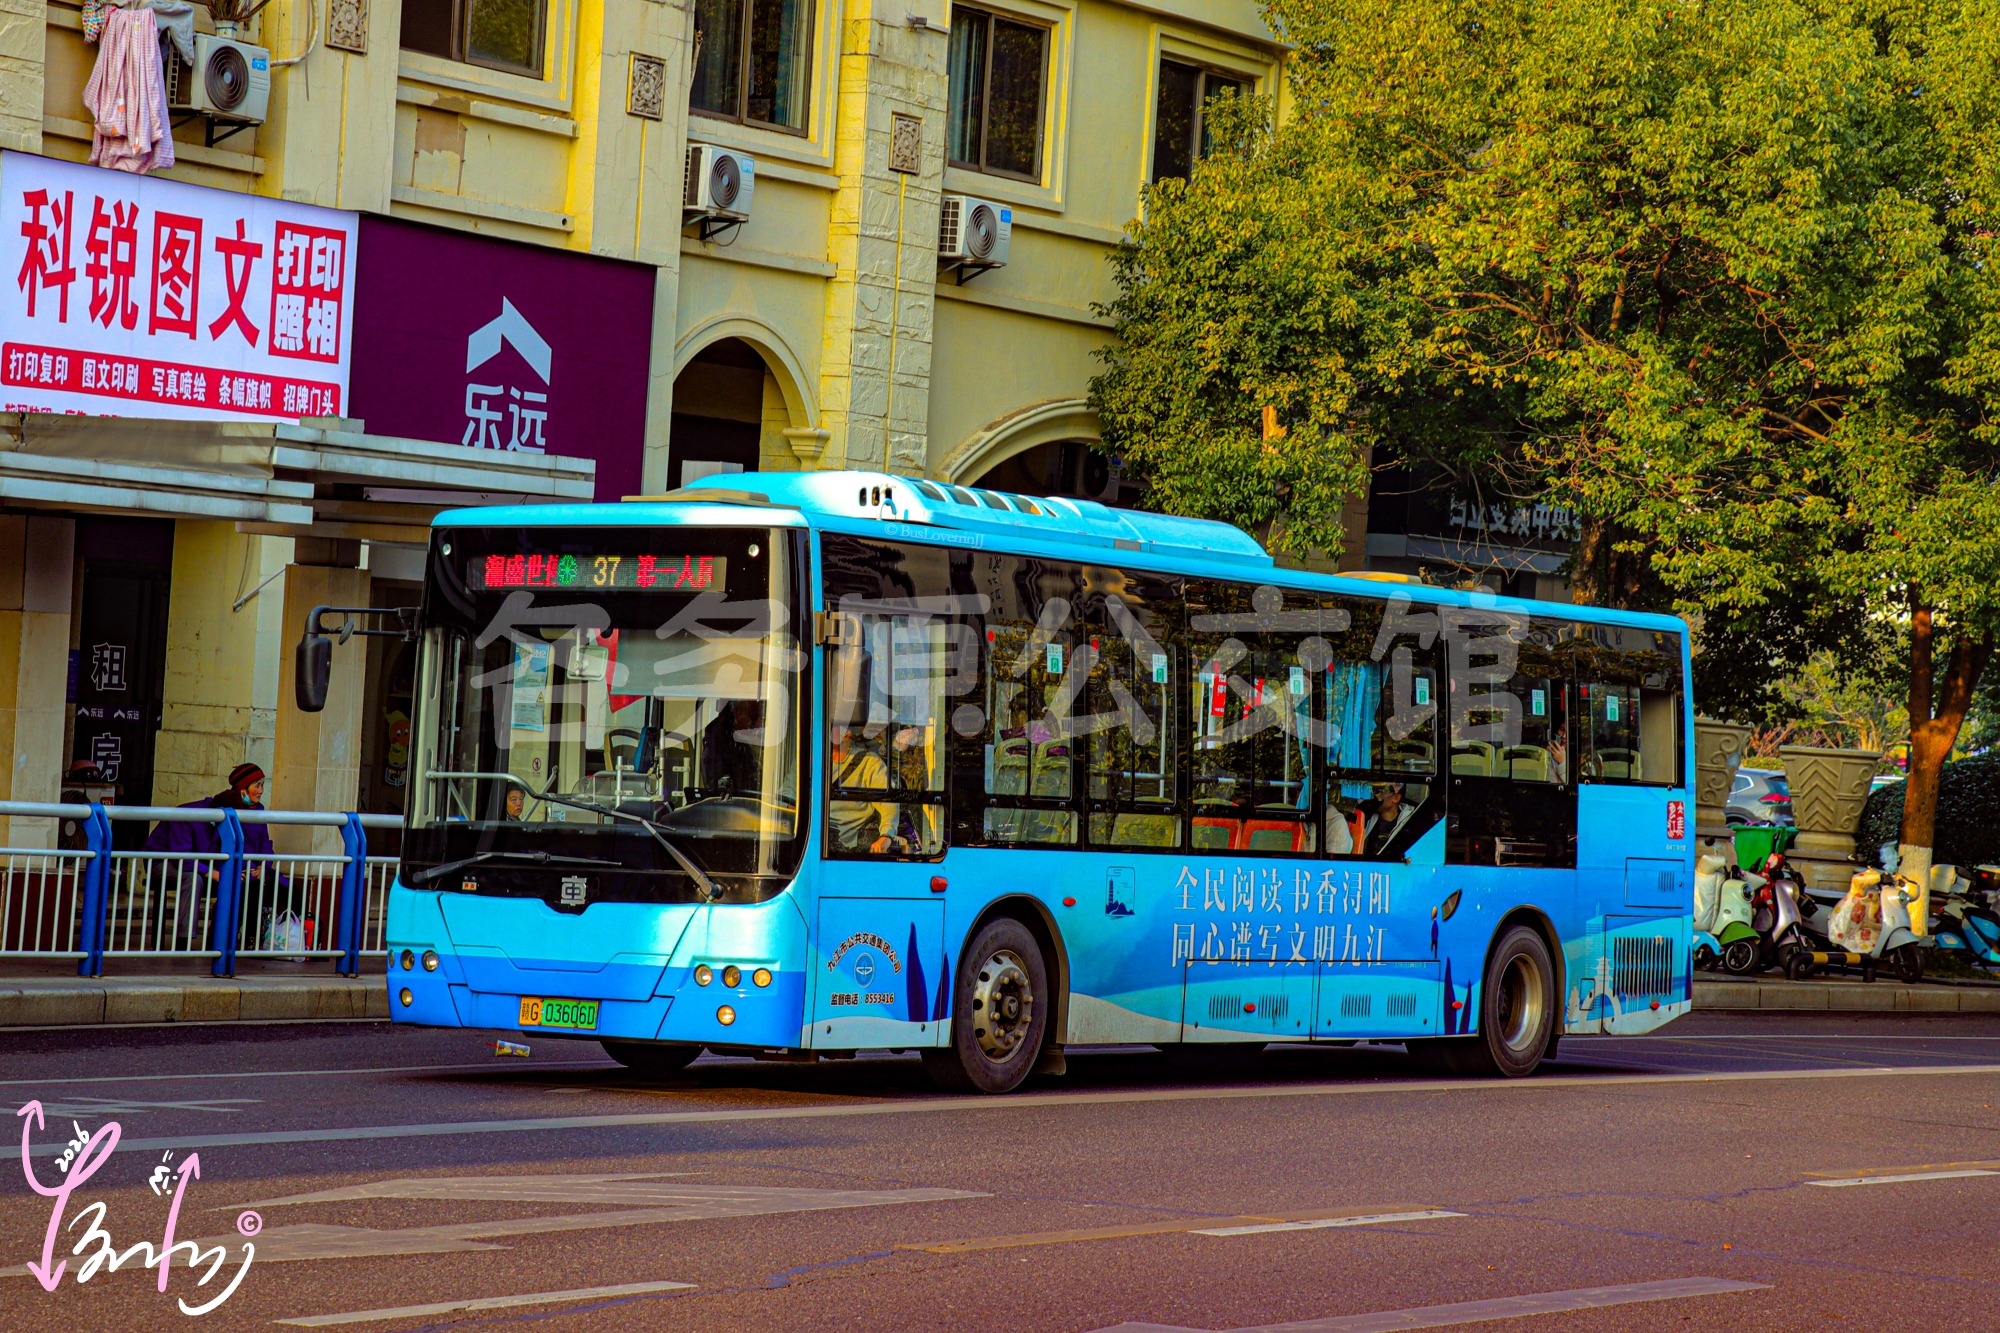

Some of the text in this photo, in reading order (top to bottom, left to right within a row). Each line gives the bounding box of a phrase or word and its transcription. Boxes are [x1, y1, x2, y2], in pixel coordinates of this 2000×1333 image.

[18, 188, 263, 348] 科锐图文
[278, 230, 341, 292] 打印
[274, 294, 338, 356] 照相
[9, 349, 334, 415] 打印复印 图文印刷 写真喷绘 条幅旗帜 招牌门头
[462, 383, 548, 454] 乐远
[593, 556, 620, 586] 37
[91, 642, 126, 690] 租
[91, 732, 122, 782] 房
[1172, 921, 1388, 968] 同心谱写文明九江
